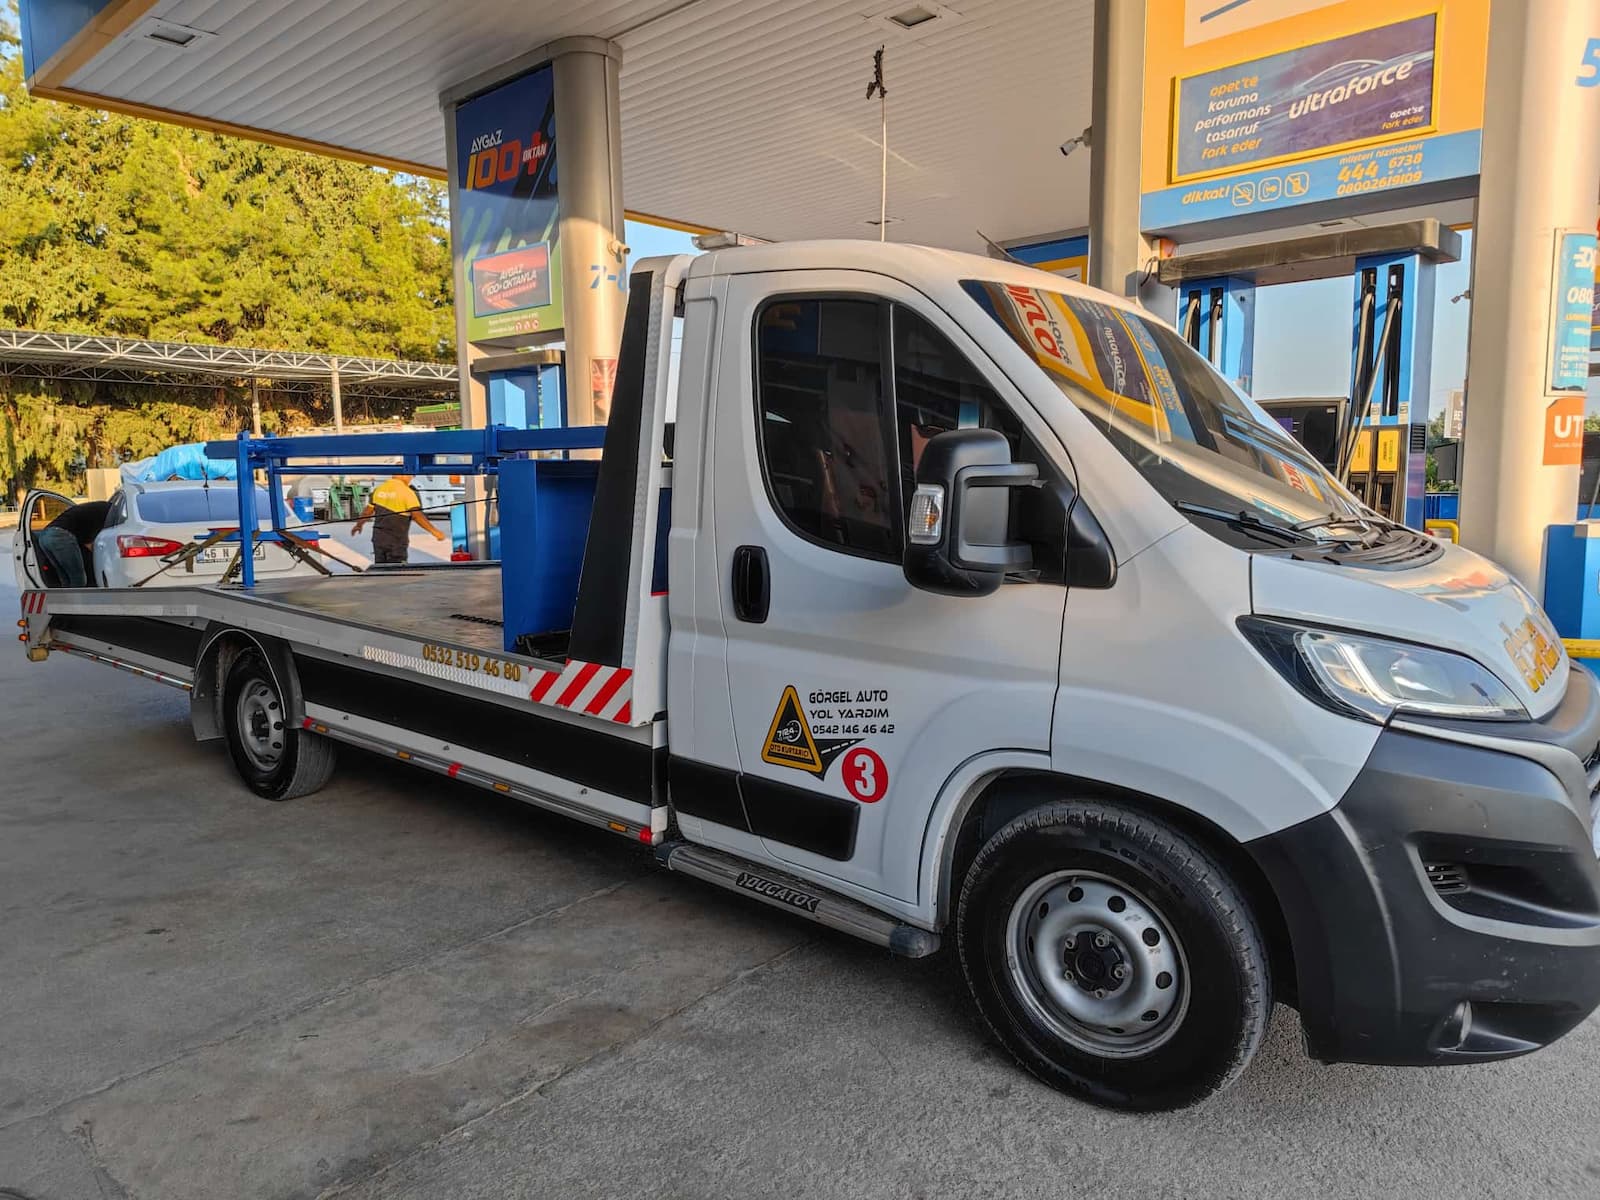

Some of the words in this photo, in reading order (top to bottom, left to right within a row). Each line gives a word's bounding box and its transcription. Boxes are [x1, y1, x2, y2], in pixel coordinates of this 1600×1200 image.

[1288, 60, 1415, 119] ultraforce
[1208, 92, 1258, 113] koruma
[1194, 104, 1272, 132] performans
[471, 130, 503, 154] AYGAZ
[1206, 121, 1260, 143] tasarruf
[523, 143, 548, 162] OKTAN
[1201, 144, 1228, 160] fark
[1231, 138, 1263, 154] eder
[1337, 160, 1379, 182] 444
[1388, 152, 1424, 169] 6738
[1181, 184, 1230, 205] dikkat!
[423, 644, 452, 666] 0532
[456, 651, 479, 671] 519
[483, 656, 500, 677] 46
[504, 661, 520, 681] 80
[809, 689, 852, 704] GÖRGEL
[856, 690, 888, 702] AUTO
[810, 710, 833, 719] YOL
[838, 709, 889, 719] YARDIM
[813, 725, 839, 734] 0542
[842, 725, 859, 734] 146
[862, 725, 877, 734] 46
[880, 724, 895, 733] 42
[854, 753, 876, 797] 3
[744, 877, 808, 905] DUCATO
